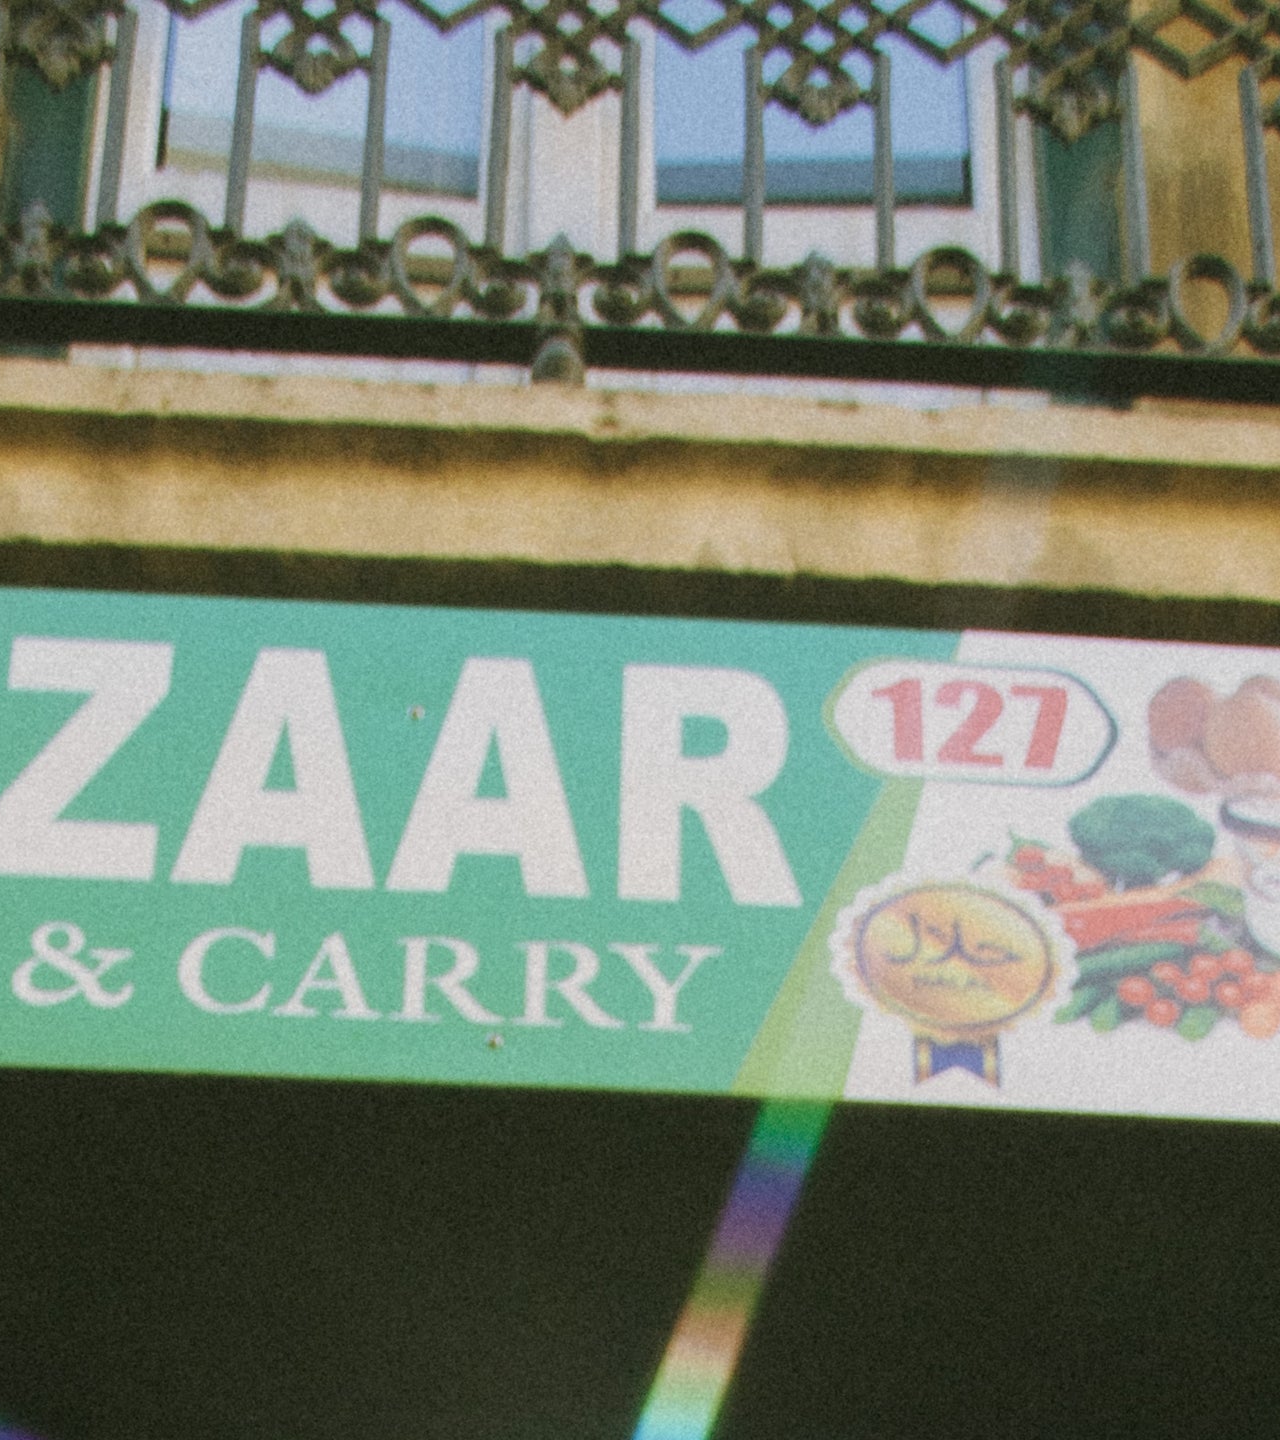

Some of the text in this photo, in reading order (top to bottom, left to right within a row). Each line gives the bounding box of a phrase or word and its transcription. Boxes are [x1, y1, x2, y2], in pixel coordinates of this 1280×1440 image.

[871, 678, 1068, 769] 127
[12, 921, 134, 1009] &
[177, 926, 724, 1032] CARRY
